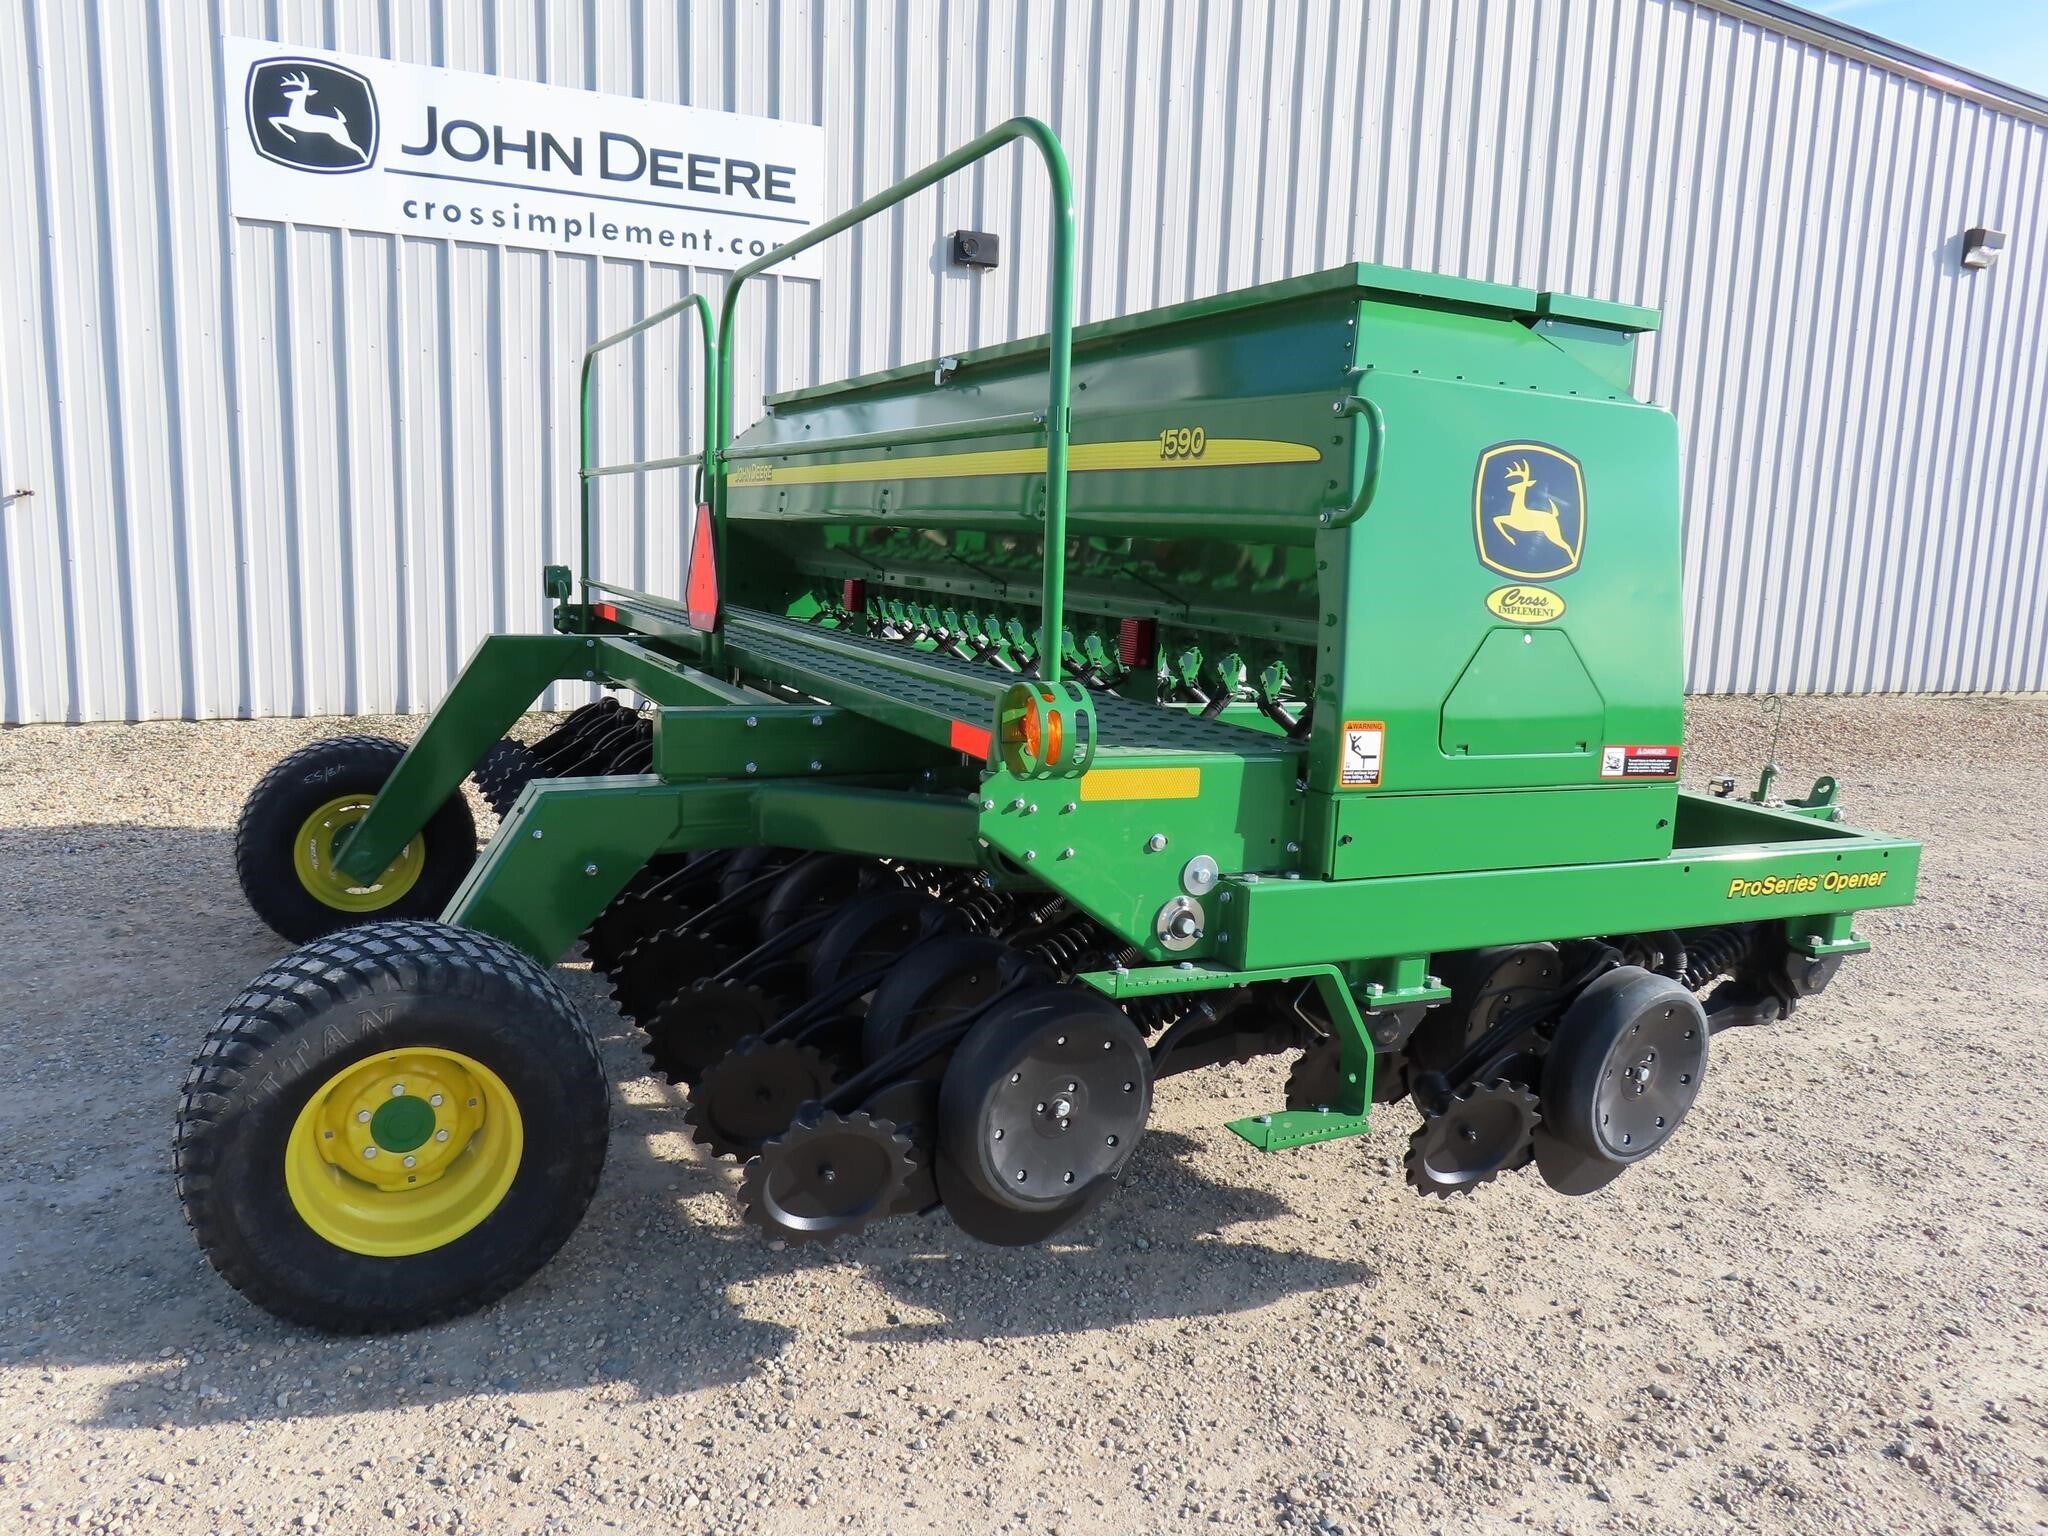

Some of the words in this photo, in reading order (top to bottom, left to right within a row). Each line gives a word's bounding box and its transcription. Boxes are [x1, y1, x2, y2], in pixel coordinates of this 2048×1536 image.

[401, 105, 583, 176] JOHN
[599, 131, 796, 204] DEERE
[1159, 427, 1206, 458] 1590
[1501, 588, 1549, 607] Cross
[1498, 605, 1555, 617] IMPLEMENT
[1822, 870, 1887, 894] Opener
